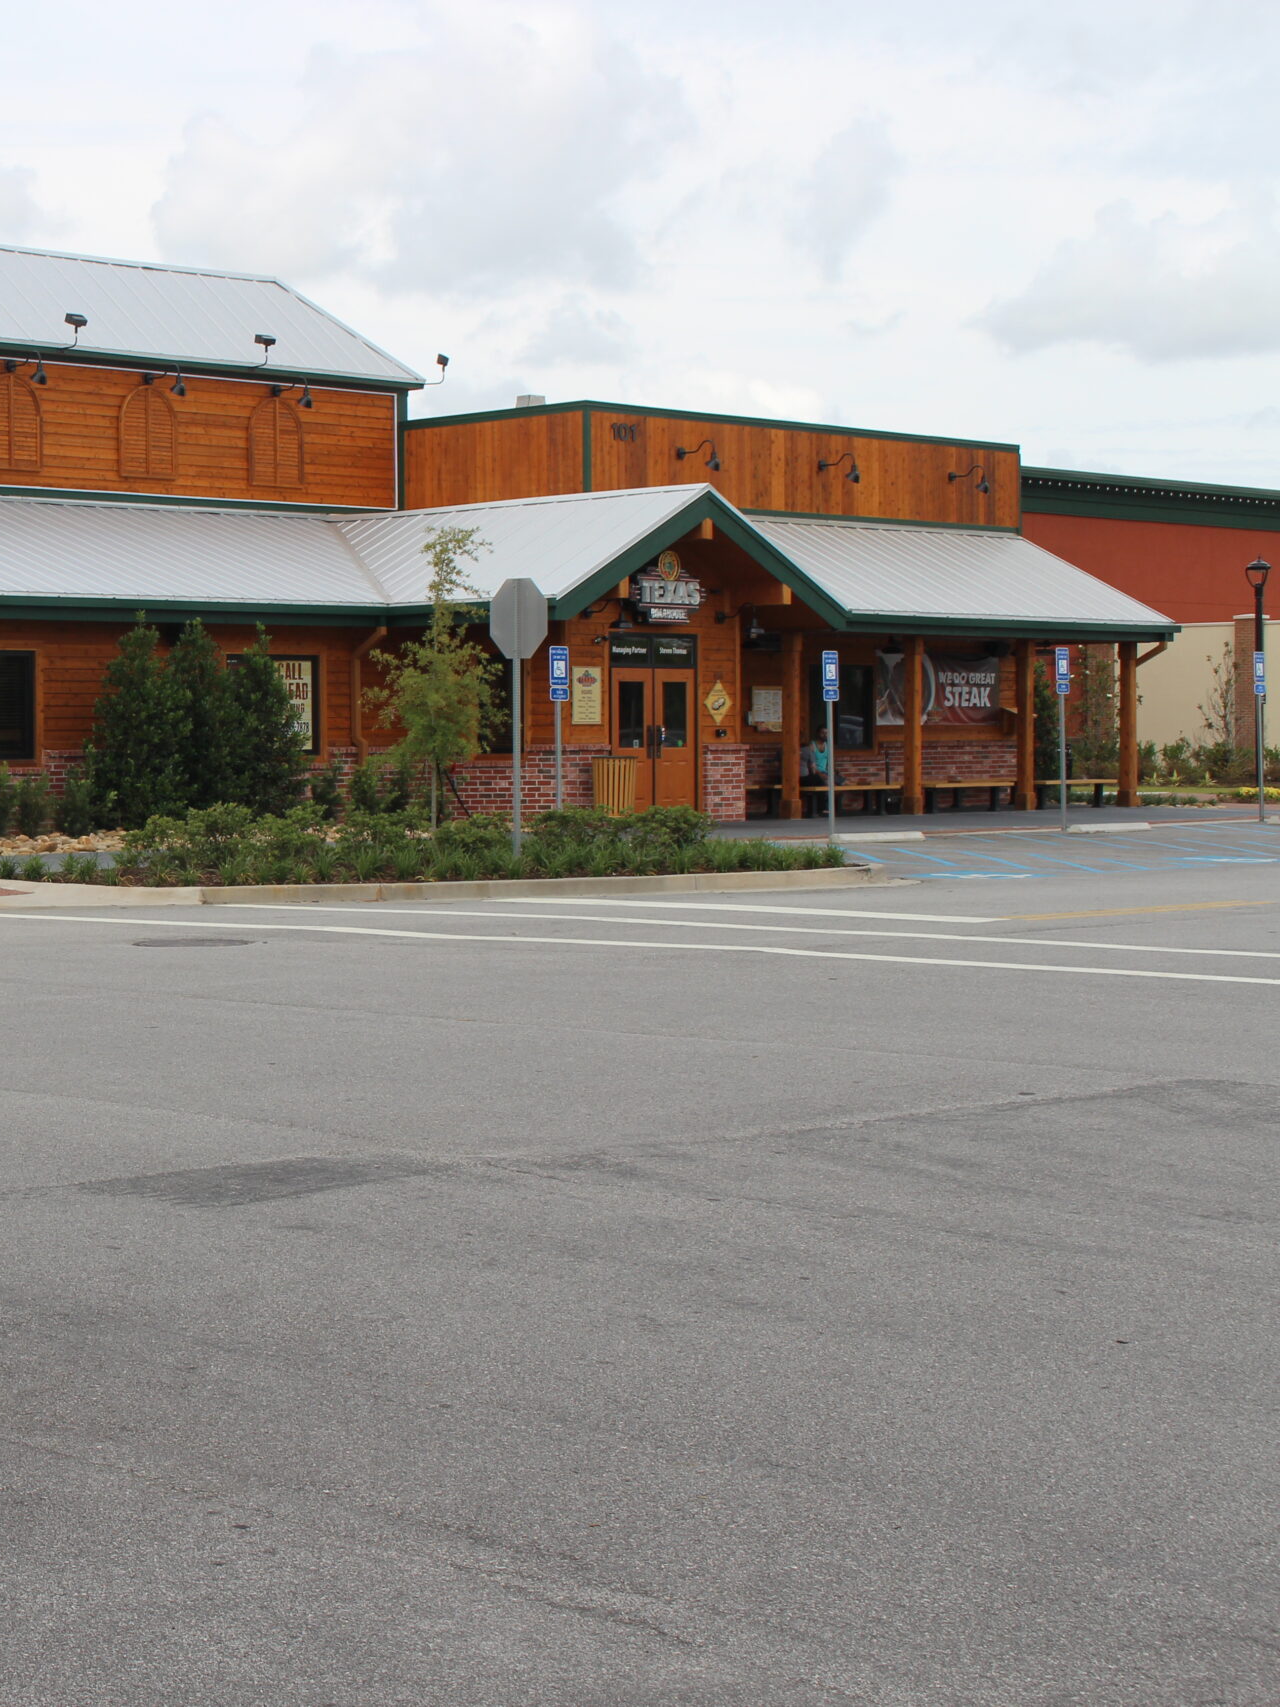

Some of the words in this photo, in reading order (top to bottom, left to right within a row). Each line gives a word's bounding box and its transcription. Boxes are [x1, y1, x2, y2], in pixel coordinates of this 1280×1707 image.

[611, 423, 636, 442] 101
[641, 581, 700, 605] TEXAS
[277, 662, 304, 680] CALL
[938, 671, 953, 684] WE
[953, 672, 968, 684] DO
[968, 672, 996, 685] GREAT
[943, 686, 991, 708] STEAK
